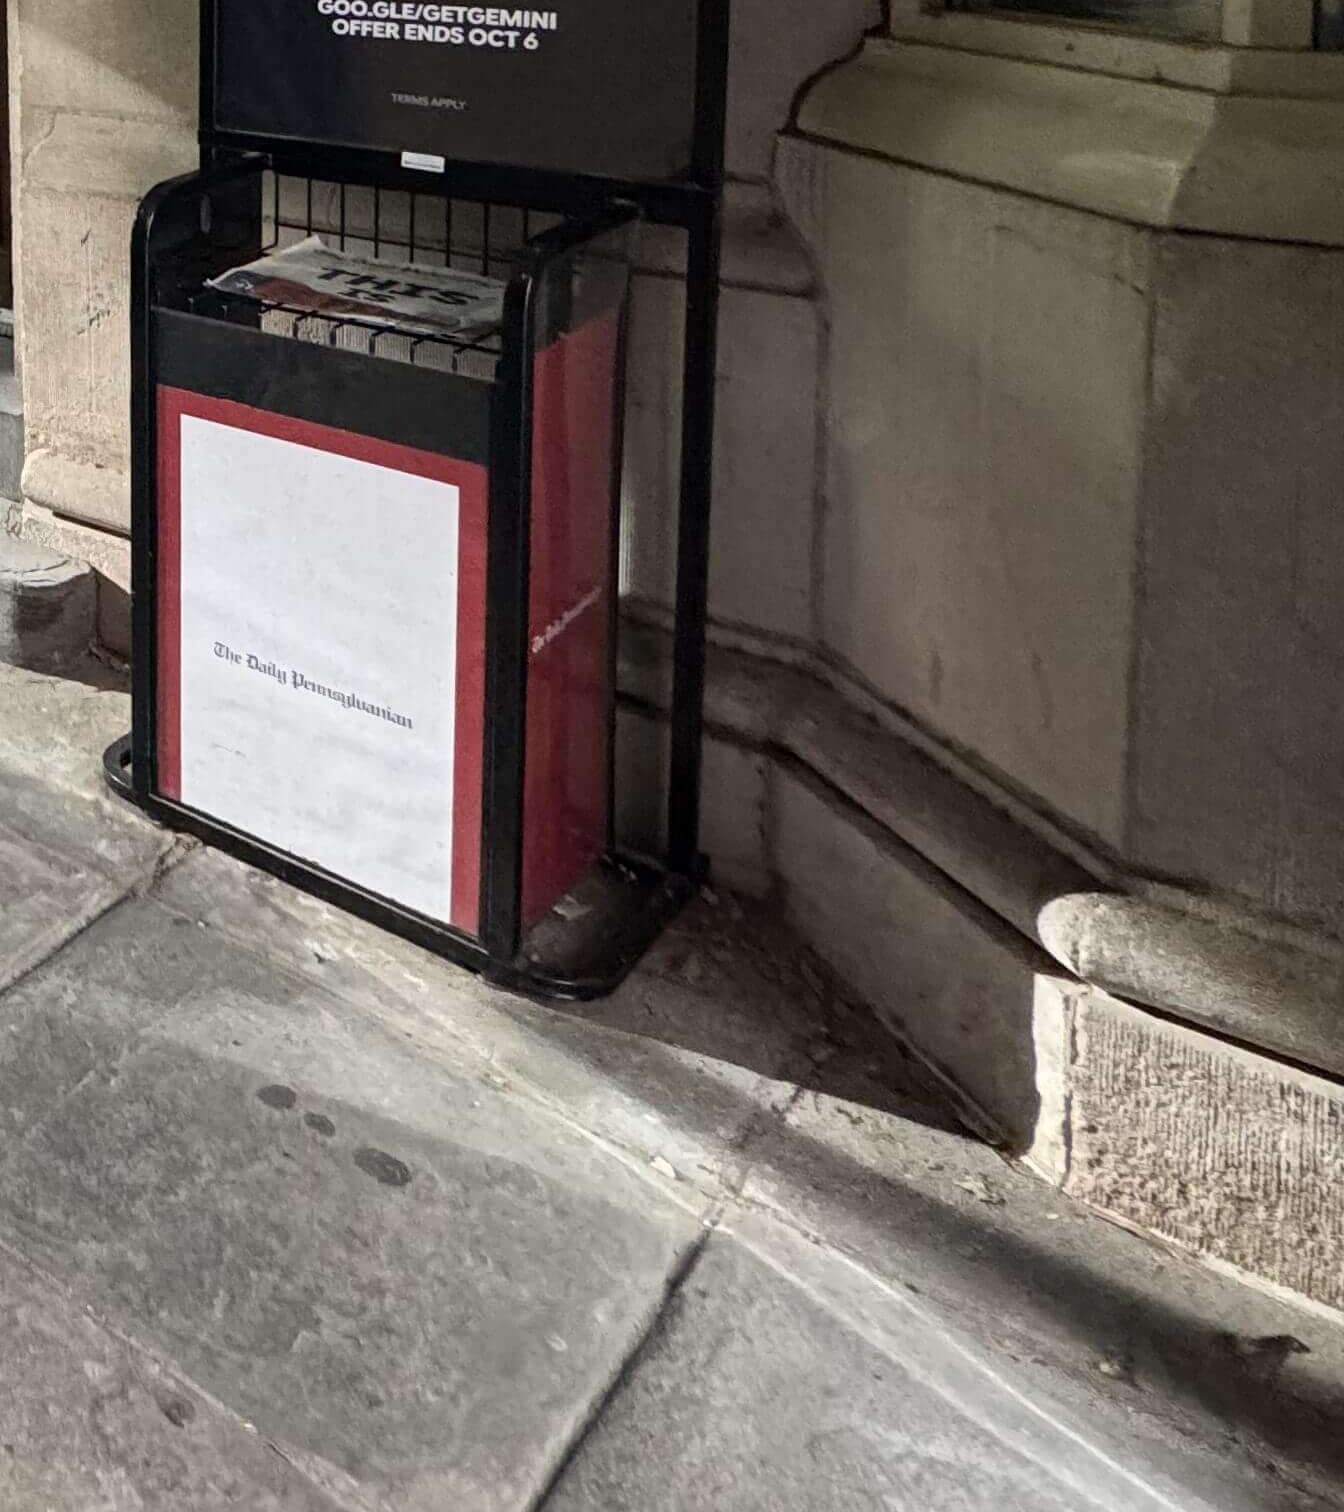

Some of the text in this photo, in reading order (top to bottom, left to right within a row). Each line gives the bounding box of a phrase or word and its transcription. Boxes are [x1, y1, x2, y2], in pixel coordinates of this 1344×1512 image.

[332, 19, 539, 50] OFFER ENDS OCT 6
[391, 93, 466, 111] TERMS APPLY
[317, 267, 479, 305] THIS
[213, 641, 413, 730] The Daily Pennsylvanian
